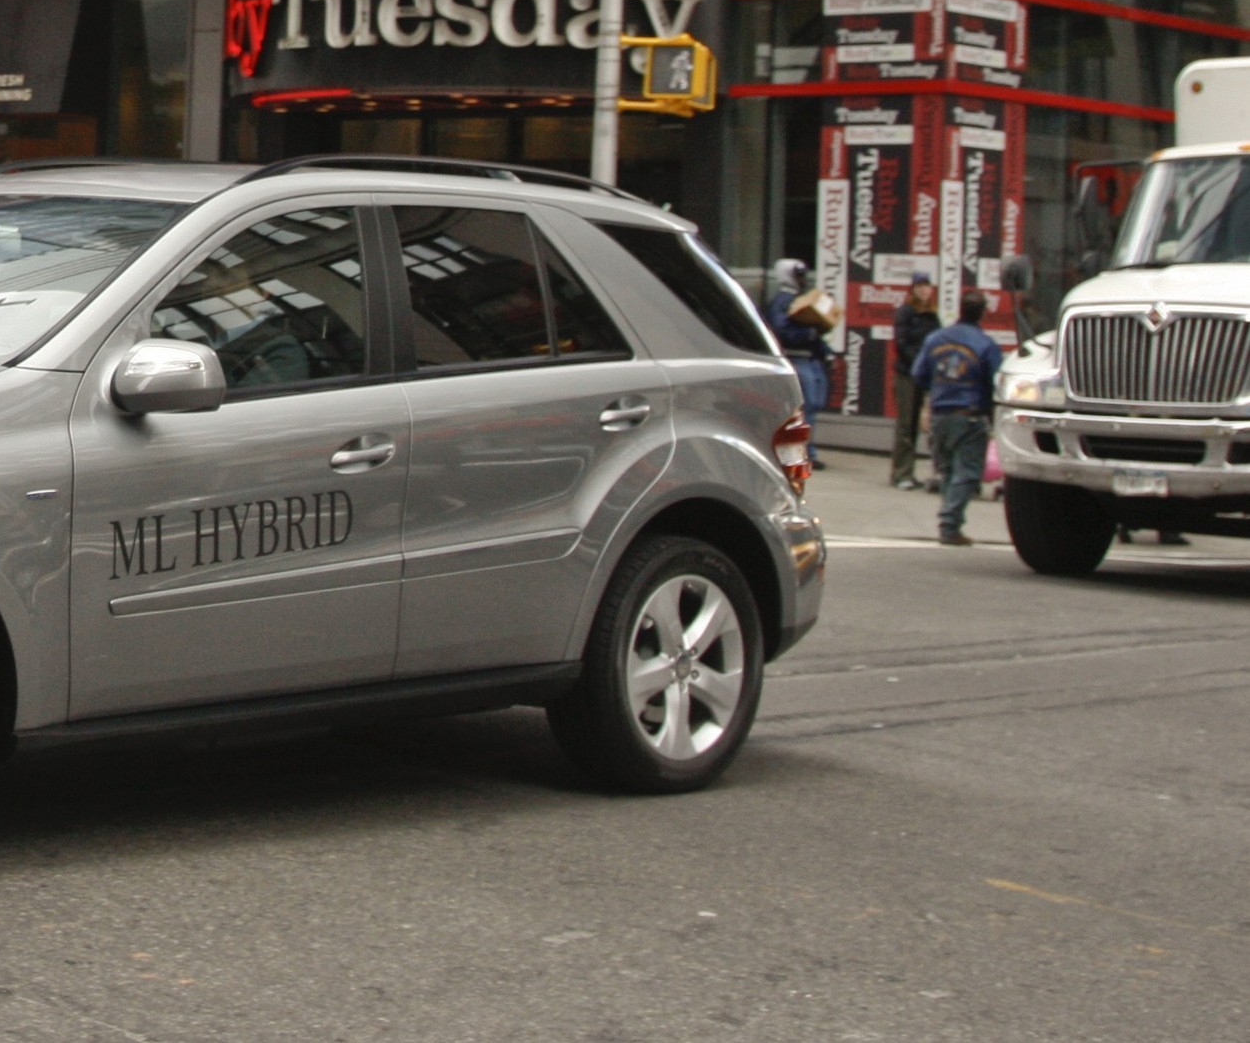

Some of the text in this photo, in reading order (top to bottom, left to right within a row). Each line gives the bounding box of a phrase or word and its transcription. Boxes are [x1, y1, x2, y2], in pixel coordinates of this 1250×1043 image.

[819, 188, 843, 256] Ruby
[850, 148, 880, 270] Tuesday
[913, 192, 938, 253] Ruby
[963, 151, 985, 274] Tuesday
[859, 284, 908, 308] Ruby
[109, 489, 353, 580] ML HYBRID
